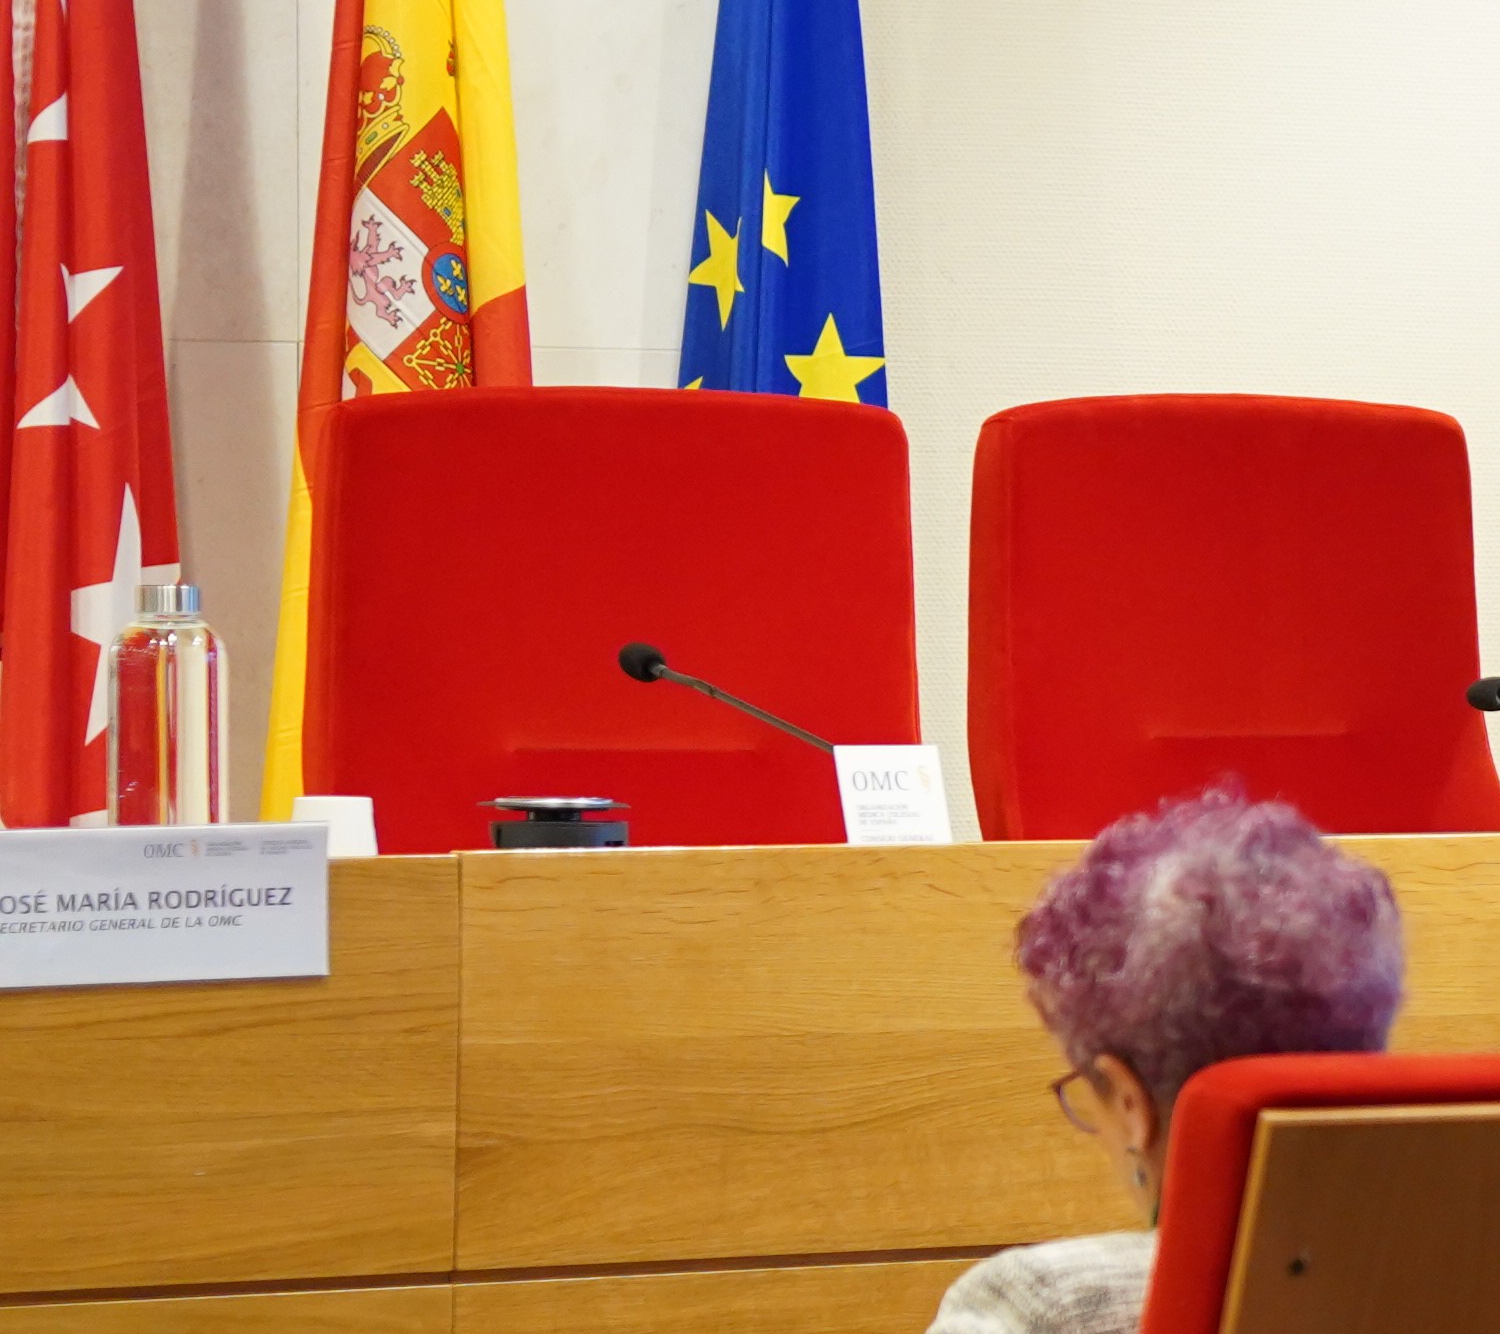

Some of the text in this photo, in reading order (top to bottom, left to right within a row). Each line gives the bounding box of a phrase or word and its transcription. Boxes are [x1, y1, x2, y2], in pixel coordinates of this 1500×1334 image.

[852, 770, 910, 791] OMC
[143, 842, 185, 858] OMC
[56, 887, 139, 913] MARÍA
[147, 884, 294, 911] RODRÍGUEZ
[88, 917, 154, 933] GENERAL
[160, 917, 181, 929] DE
[184, 916, 204, 928] LA
[207, 914, 244, 927] OMC
